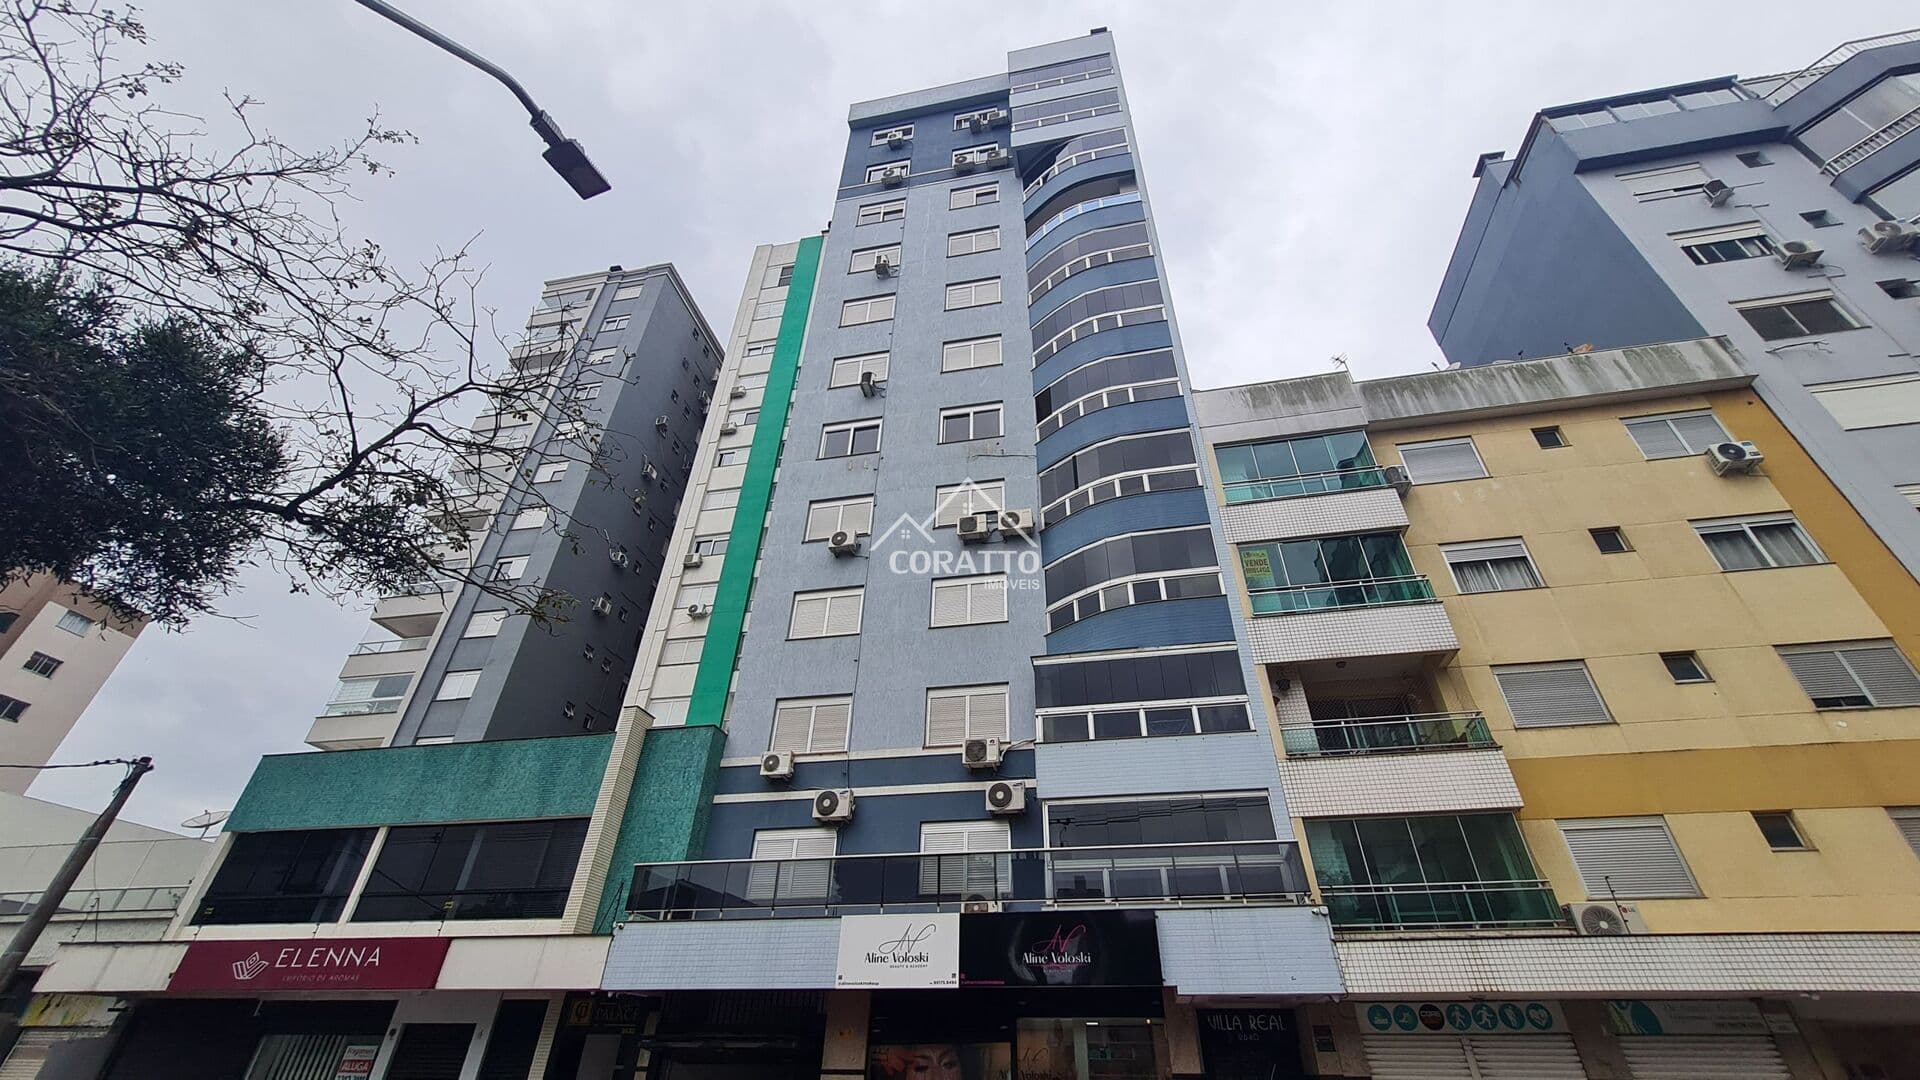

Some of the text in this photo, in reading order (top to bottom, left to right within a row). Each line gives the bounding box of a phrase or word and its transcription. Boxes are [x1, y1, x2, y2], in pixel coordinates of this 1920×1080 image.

[1244, 558, 1269, 567] VENDE
[274, 946, 380, 968] ELENNA
[864, 951, 929, 963] Aline Voloski
[1023, 951, 1091, 964] Aline Voloski
[1207, 1014, 1288, 1031] VILLA REAL
[341, 1061, 370, 1071] ALUGA
